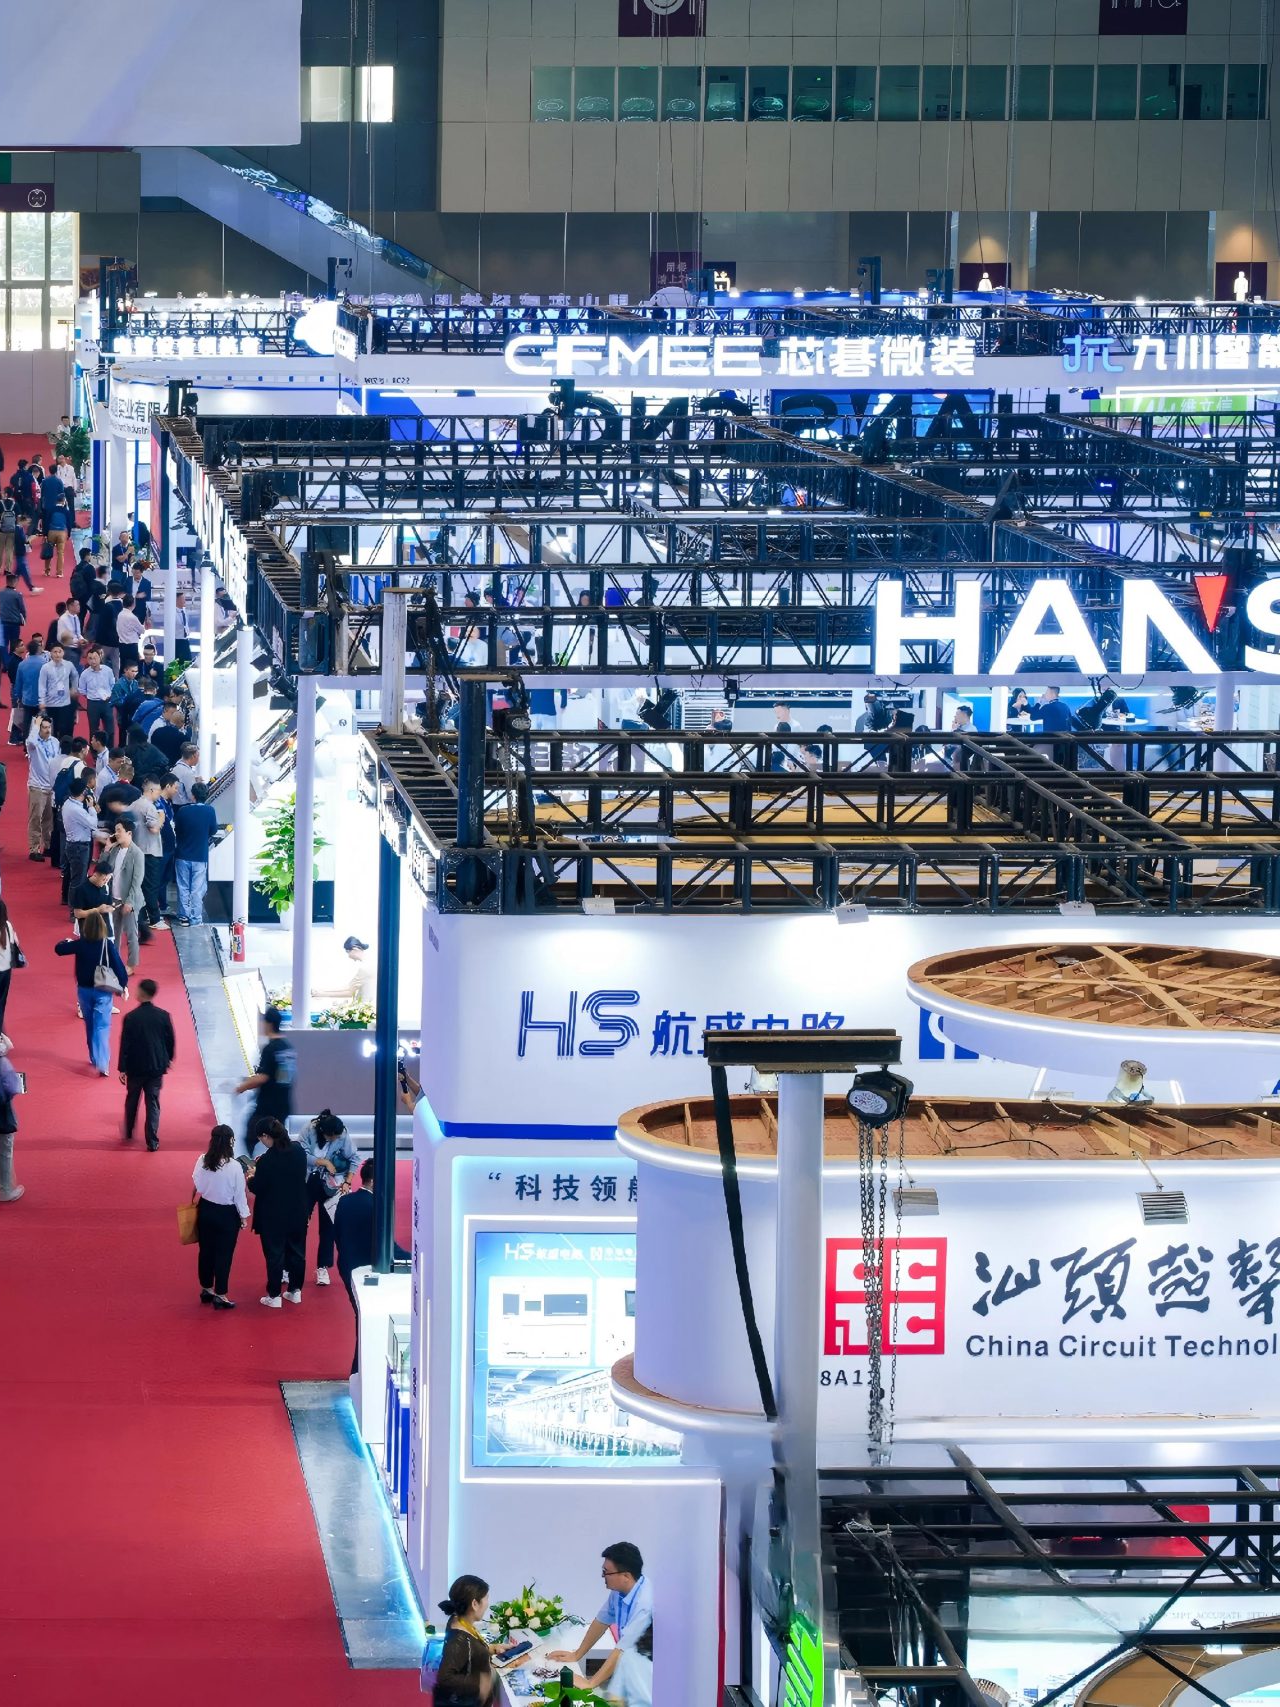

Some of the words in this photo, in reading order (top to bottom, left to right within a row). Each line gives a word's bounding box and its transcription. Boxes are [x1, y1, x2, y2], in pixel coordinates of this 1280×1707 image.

[779, 335, 975, 377] 芯碁微装
[516, 990, 641, 1058] HS
[966, 1335, 1049, 1357] China
[1058, 1334, 1157, 1357] Circuit
[1164, 1334, 1278, 1357] Technol
